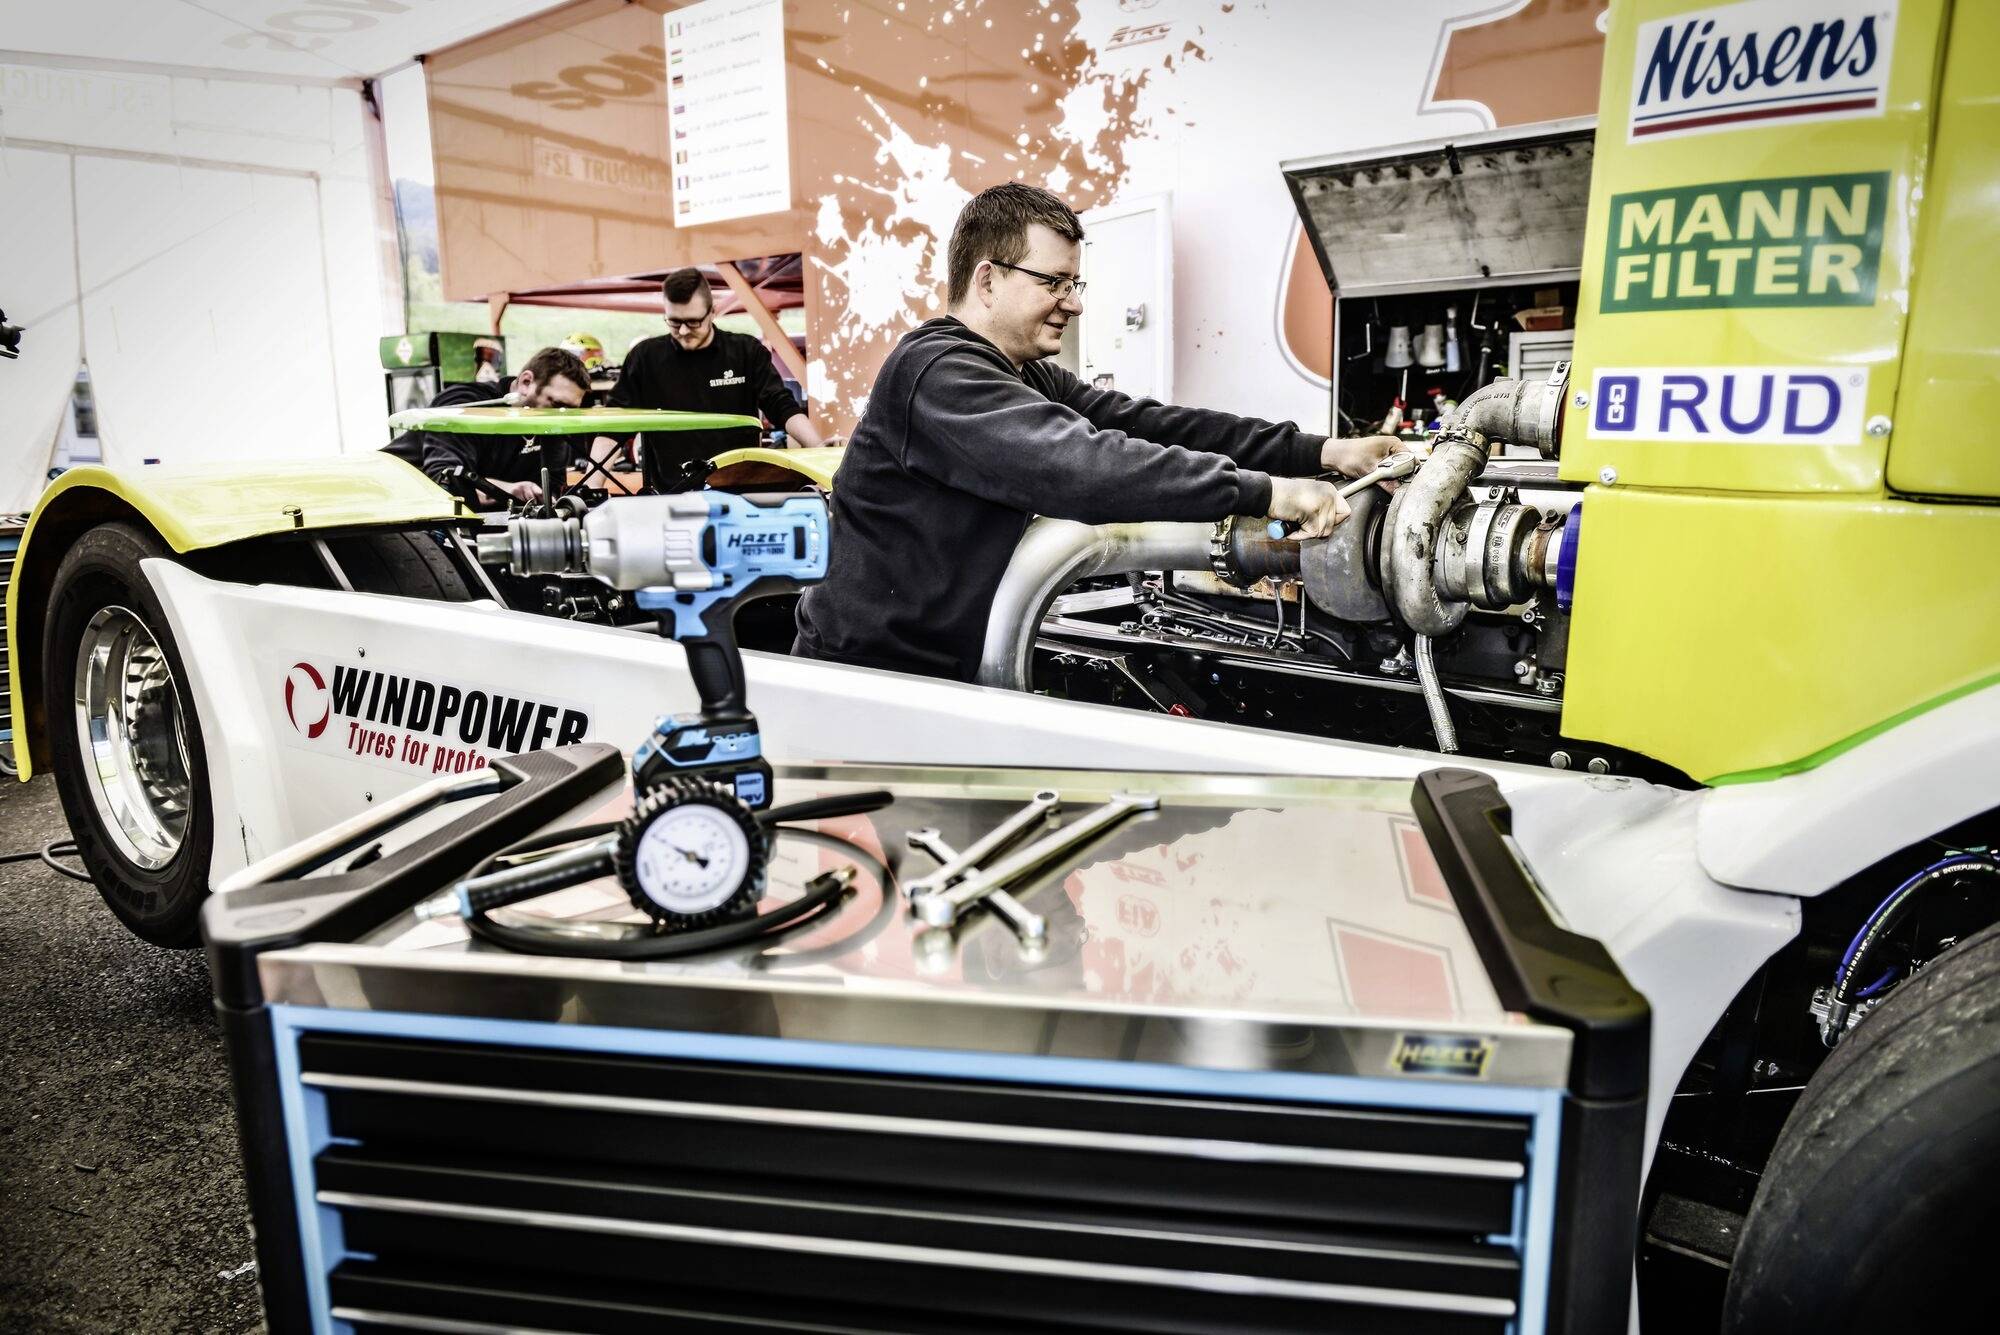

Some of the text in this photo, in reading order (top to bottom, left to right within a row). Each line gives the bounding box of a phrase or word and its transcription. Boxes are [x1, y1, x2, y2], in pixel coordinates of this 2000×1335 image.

[1638, 16, 1877, 106] Nissens
[1619, 183, 1871, 249] MANN
[1613, 243, 1863, 301] FILTER
[1658, 374, 1841, 435] RUD
[728, 532, 789, 548] HAZET
[332, 665, 589, 754] WINDPOWER
[348, 722, 397, 759] Tyres
[400, 734, 430, 766] for
